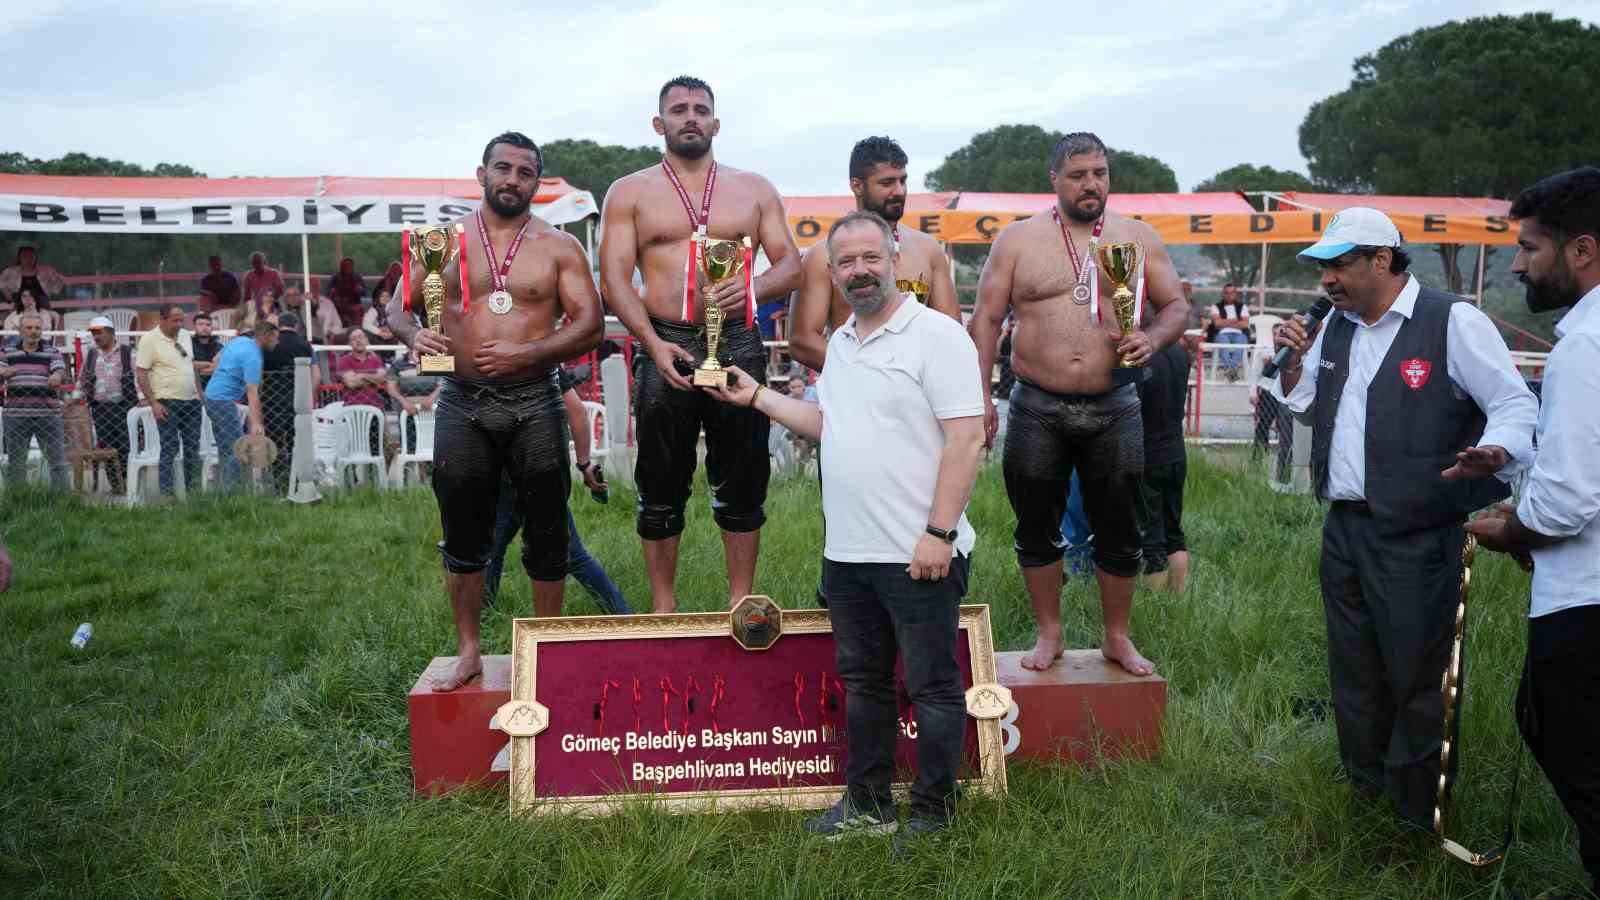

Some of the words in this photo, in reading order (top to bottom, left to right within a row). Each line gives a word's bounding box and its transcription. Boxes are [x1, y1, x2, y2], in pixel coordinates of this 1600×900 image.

[18, 199, 473, 225] BELEDİYES
[561, 733, 621, 755] Gömeç
[625, 730, 697, 753] Belediye
[701, 728, 767, 751] Başkanı
[771, 725, 818, 749] Sayın
[632, 759, 745, 784] Başpehlivana
